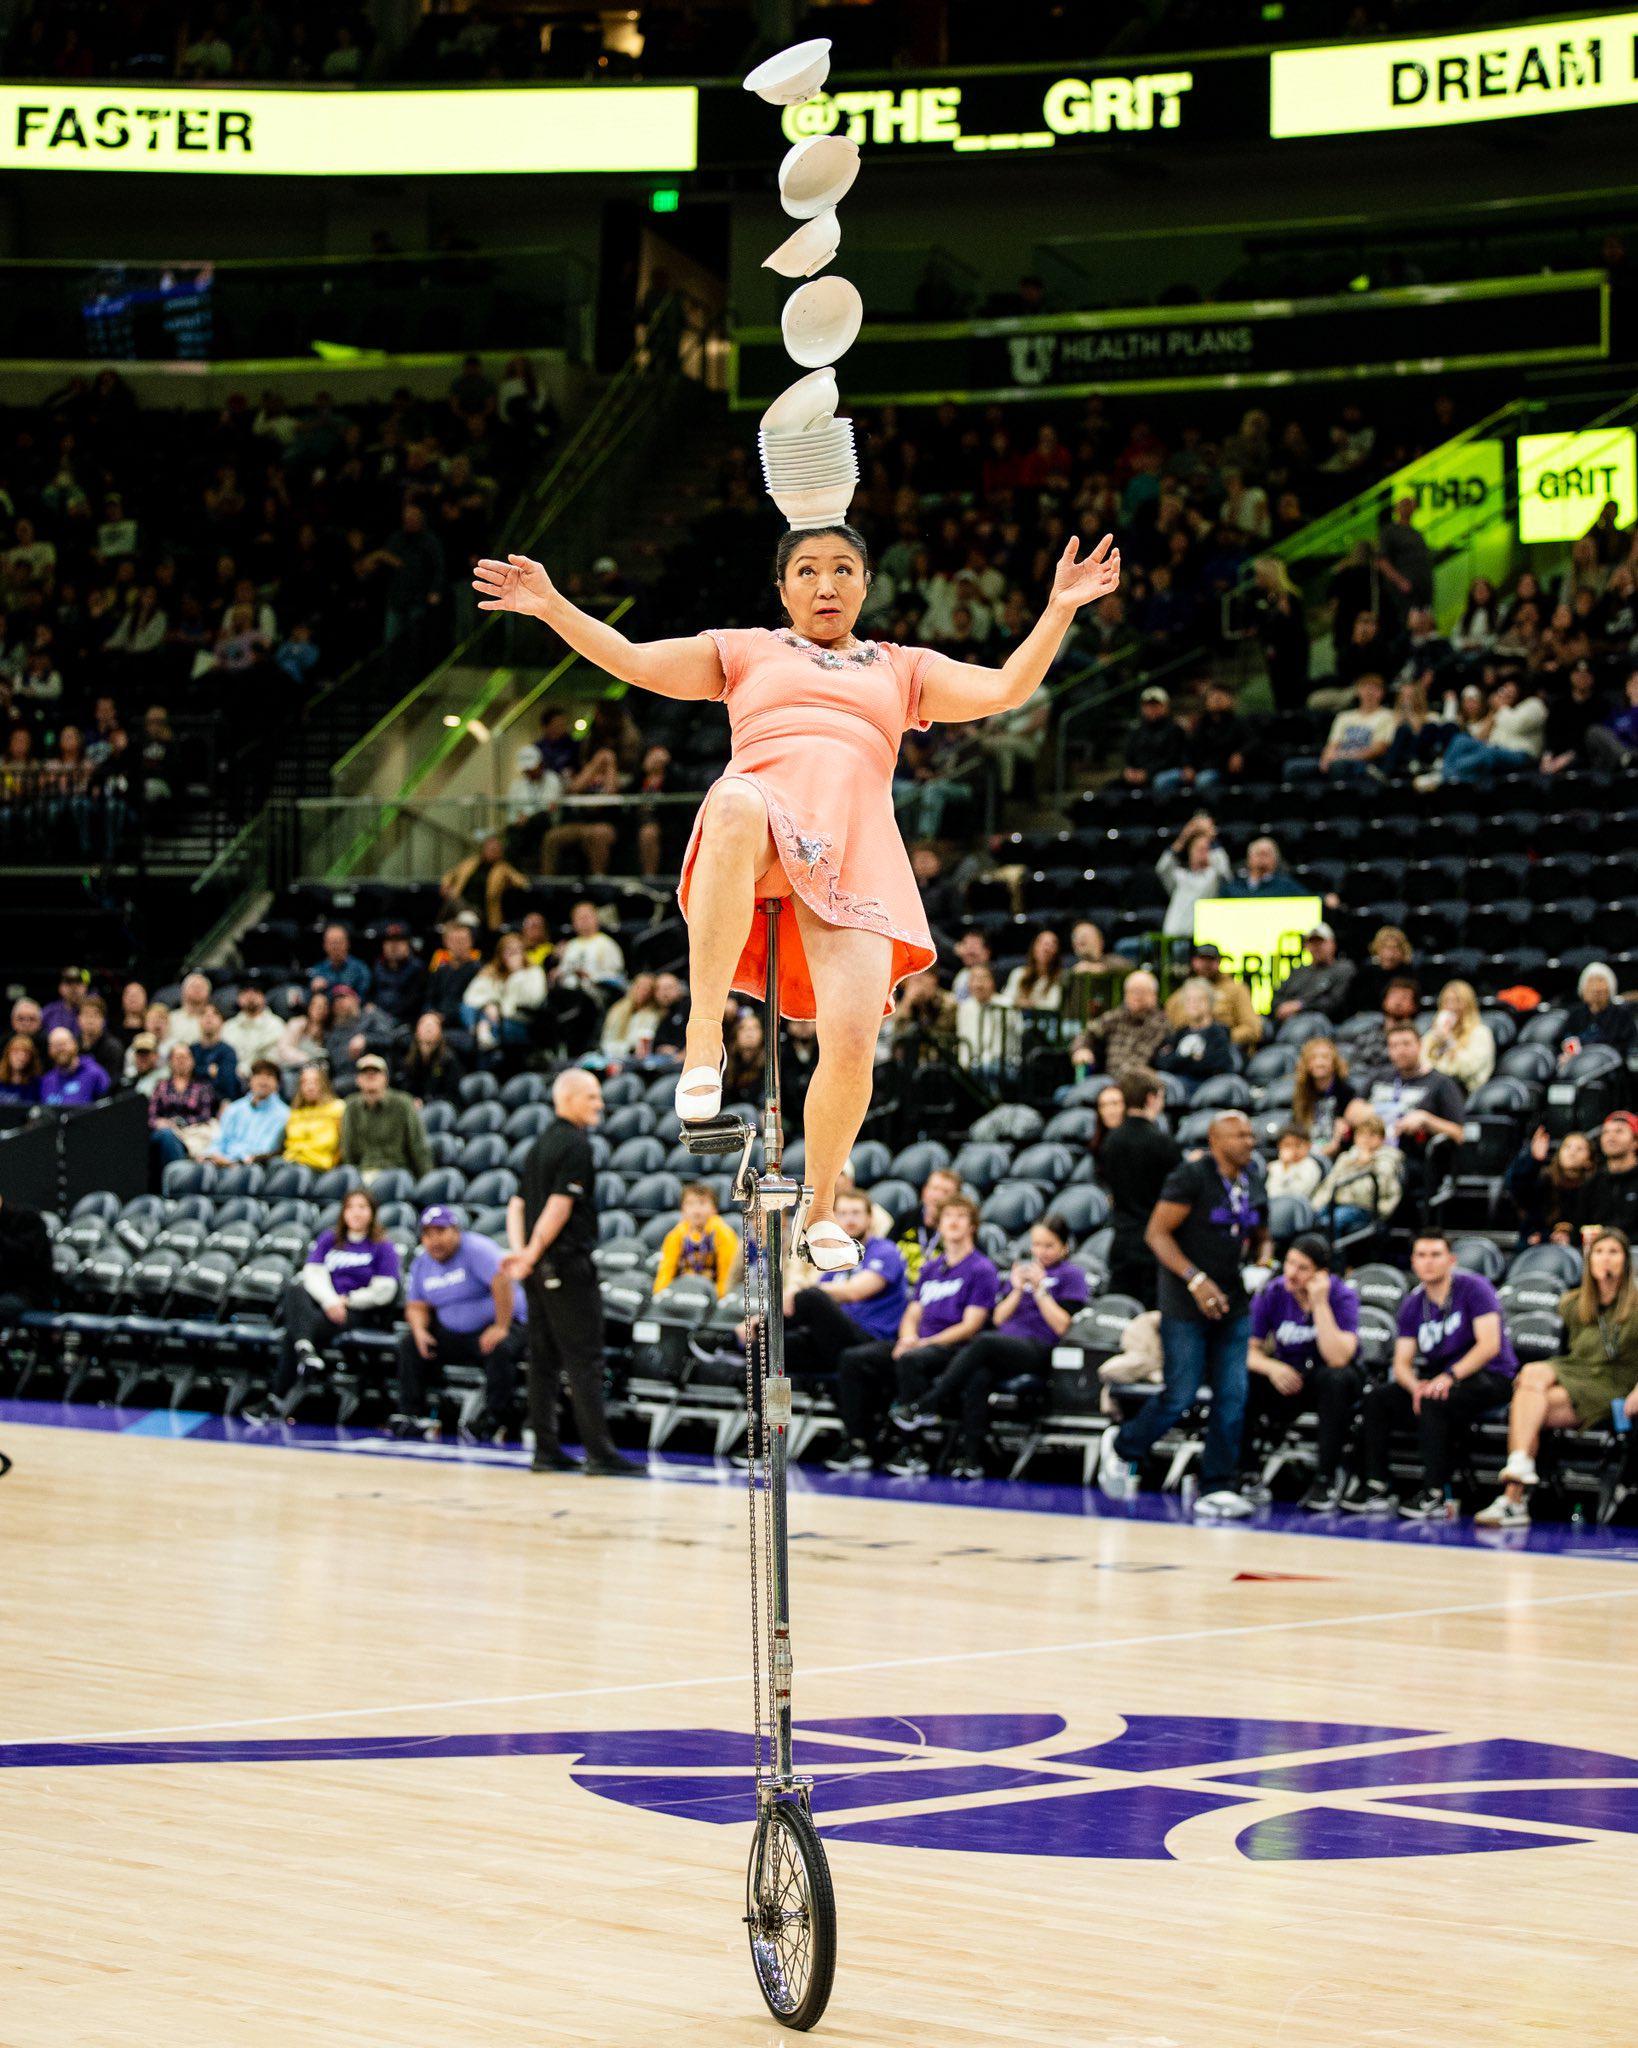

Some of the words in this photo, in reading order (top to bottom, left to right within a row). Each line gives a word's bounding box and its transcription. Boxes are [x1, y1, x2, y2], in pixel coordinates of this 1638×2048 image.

[1392, 39, 1602, 106] DREAM
[17, 105, 254, 151] FASTER
[1061, 334, 1162, 360] HEALTH
[1165, 326, 1254, 356] PLANS
[1537, 465, 1617, 500] GRIT
